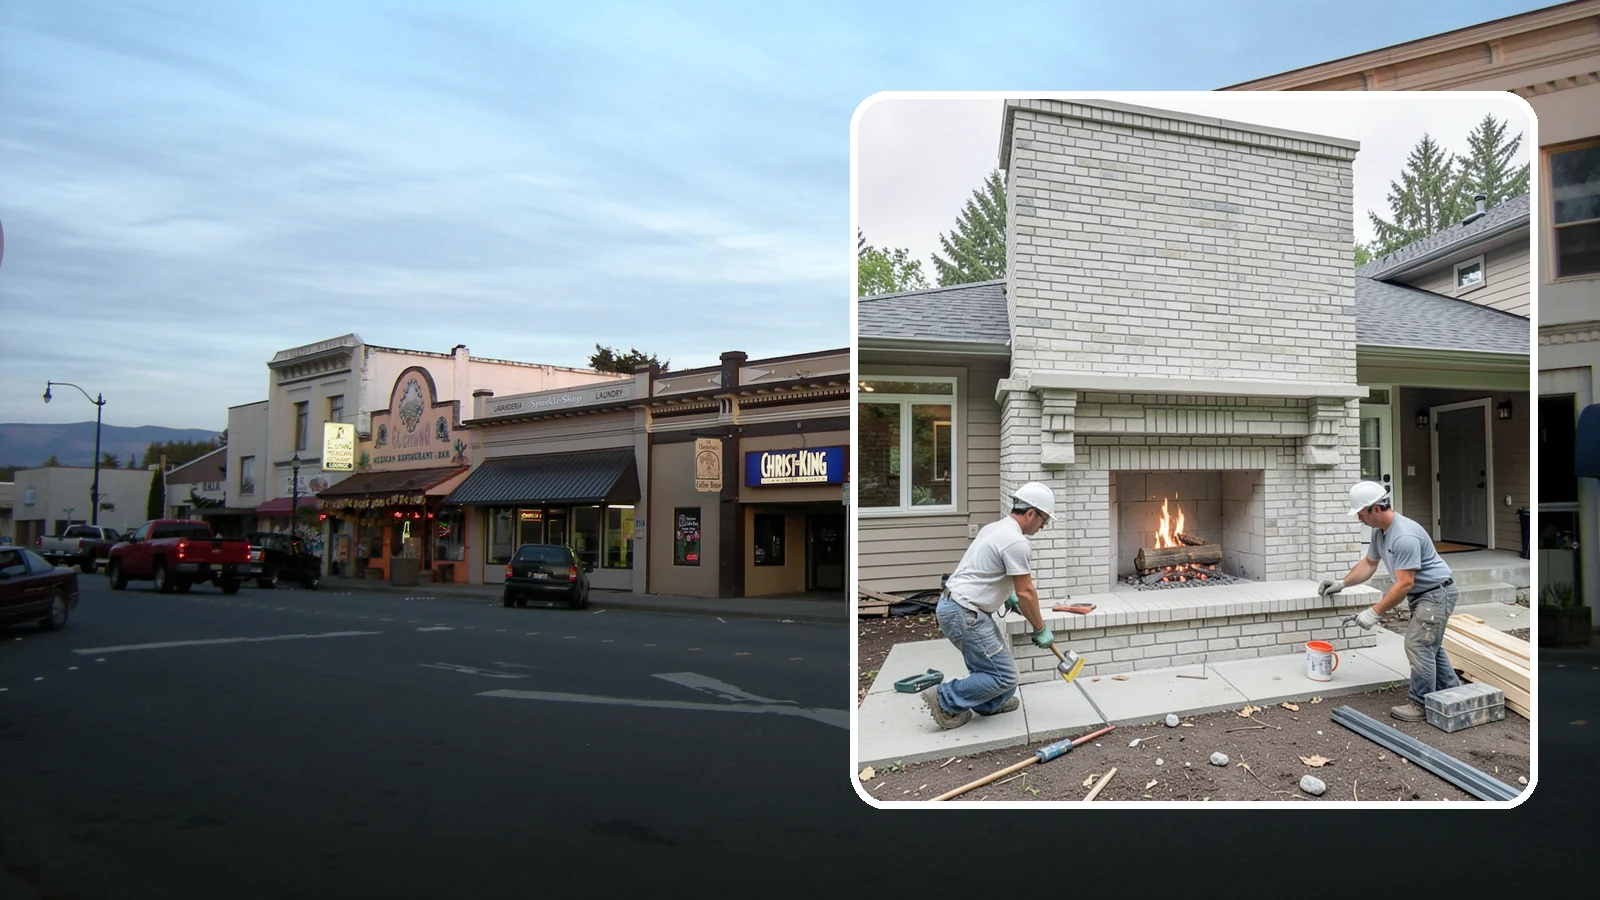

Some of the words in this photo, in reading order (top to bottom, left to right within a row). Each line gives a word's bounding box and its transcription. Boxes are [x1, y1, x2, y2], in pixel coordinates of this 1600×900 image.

[494, 402, 523, 413] LAVANDERIA
[562, 394, 582, 405] Shop
[596, 389, 624, 400] LAUNDRY
[373, 455, 396, 465] MEXICAN
[397, 451, 434, 463] RESTAURANT
[437, 449, 450, 460] BAR
[760, 452, 798, 478] CHRIST
[799, 449, 827, 477] KING
[696, 480, 710, 489] Coffee
[710, 480, 722, 489] House
